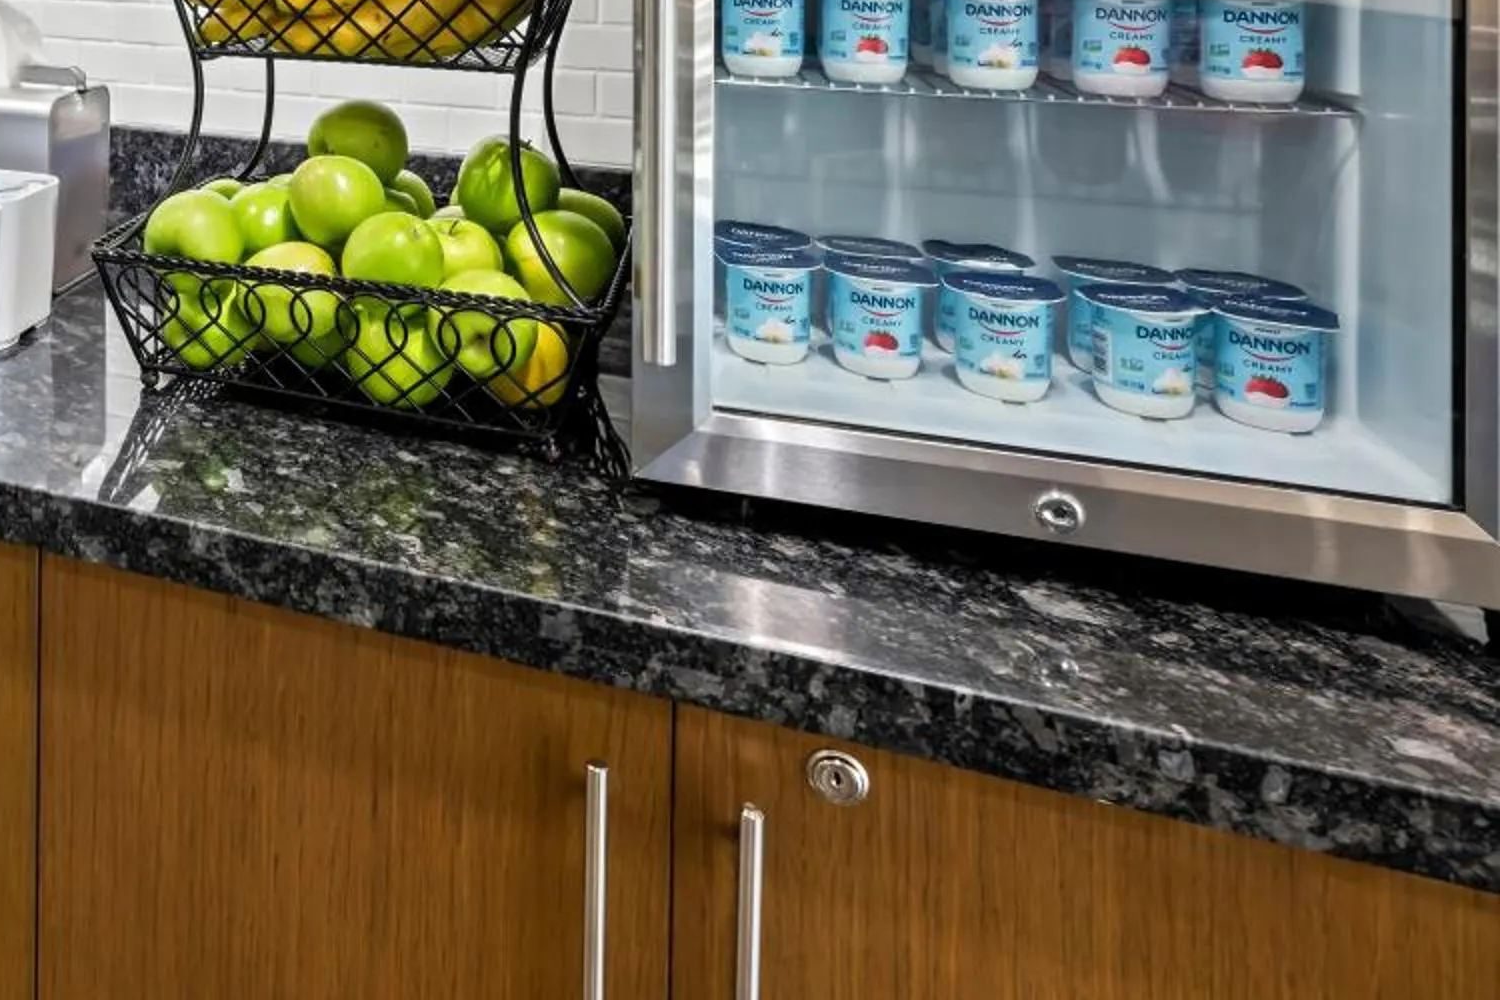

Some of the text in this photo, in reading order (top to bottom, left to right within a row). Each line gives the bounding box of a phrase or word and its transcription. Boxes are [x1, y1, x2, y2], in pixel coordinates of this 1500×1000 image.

[841, 0, 903, 12] DANNON
[965, 3, 1032, 16] DANNON
[1095, 7, 1168, 21] DANNON
[1223, 10, 1299, 24] DANNON
[1109, 31, 1153, 40] CREAMY
[1239, 35, 1287, 44] CREAMY
[743, 278, 804, 294] DANNON
[851, 291, 915, 309] DANNON
[968, 307, 1040, 328] DANNON
[1136, 325, 1194, 340] DANNO
[980, 334, 1025, 346] CREAMY
[1229, 330, 1311, 355] DANNON
[1242, 358, 1293, 373] CREAMY
